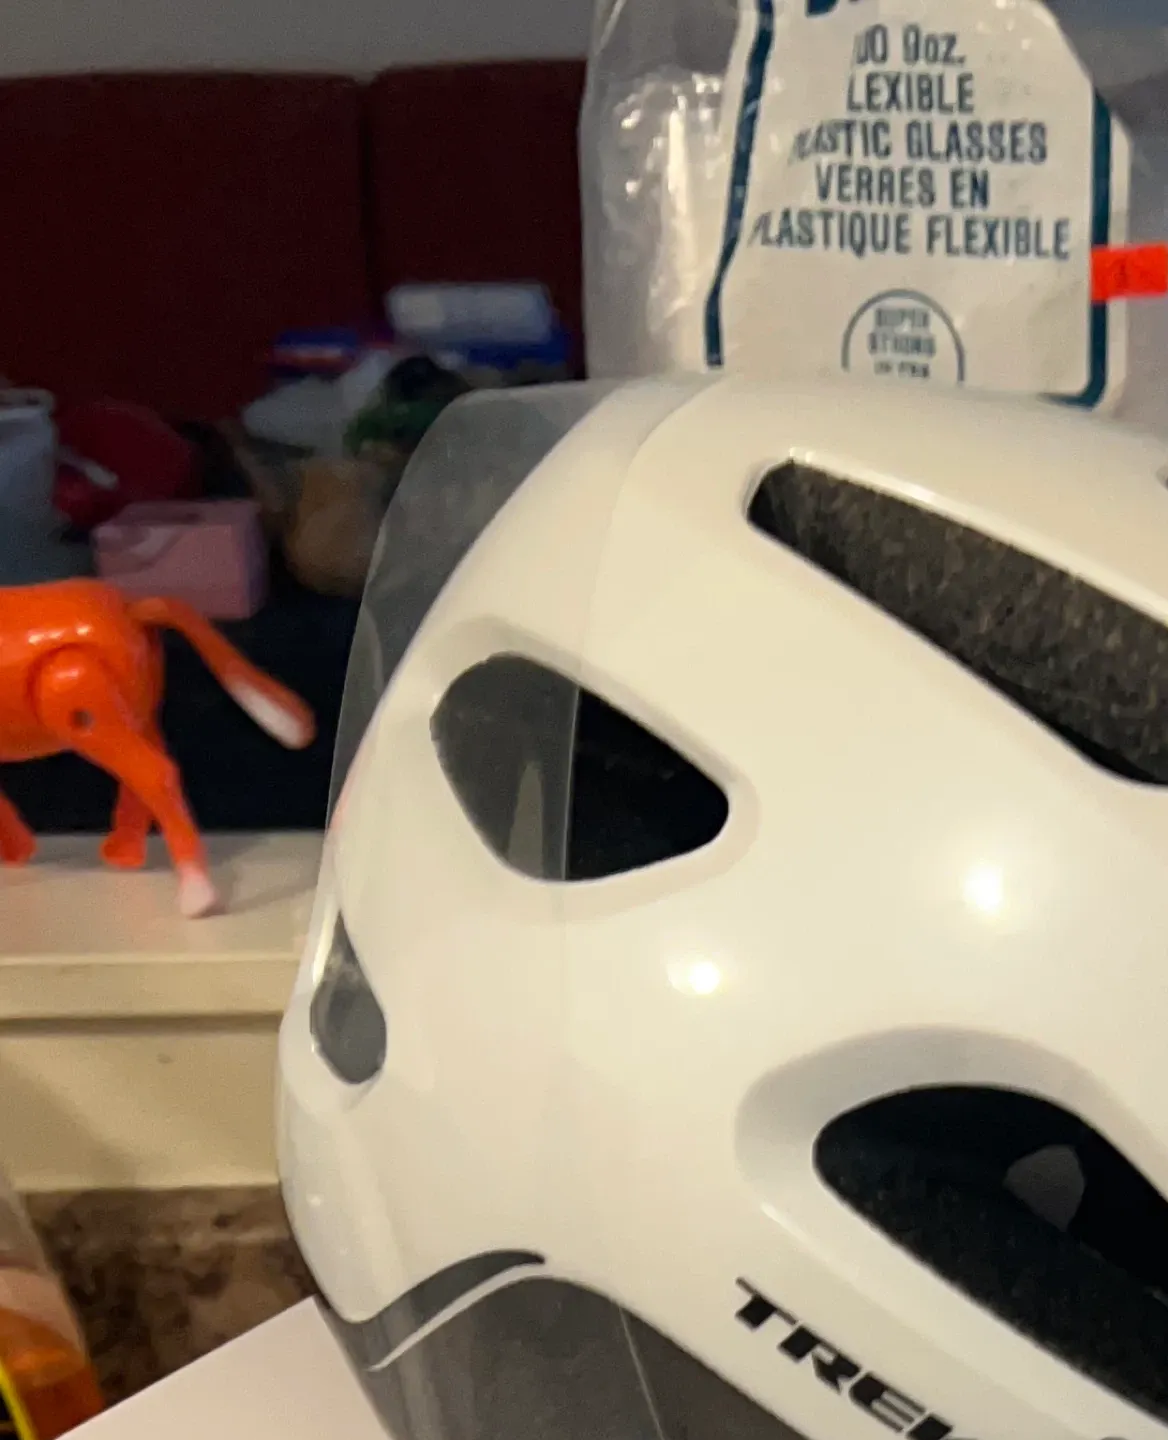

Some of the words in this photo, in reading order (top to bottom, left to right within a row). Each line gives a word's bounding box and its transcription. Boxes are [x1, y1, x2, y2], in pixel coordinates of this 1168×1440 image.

[846, 72, 974, 113] LEXIBLE
[905, 119, 1048, 163] GLASSES
[815, 162, 935, 207] VERRES
[949, 168, 990, 208] EN
[926, 214, 1070, 260] FLEXIBLE
